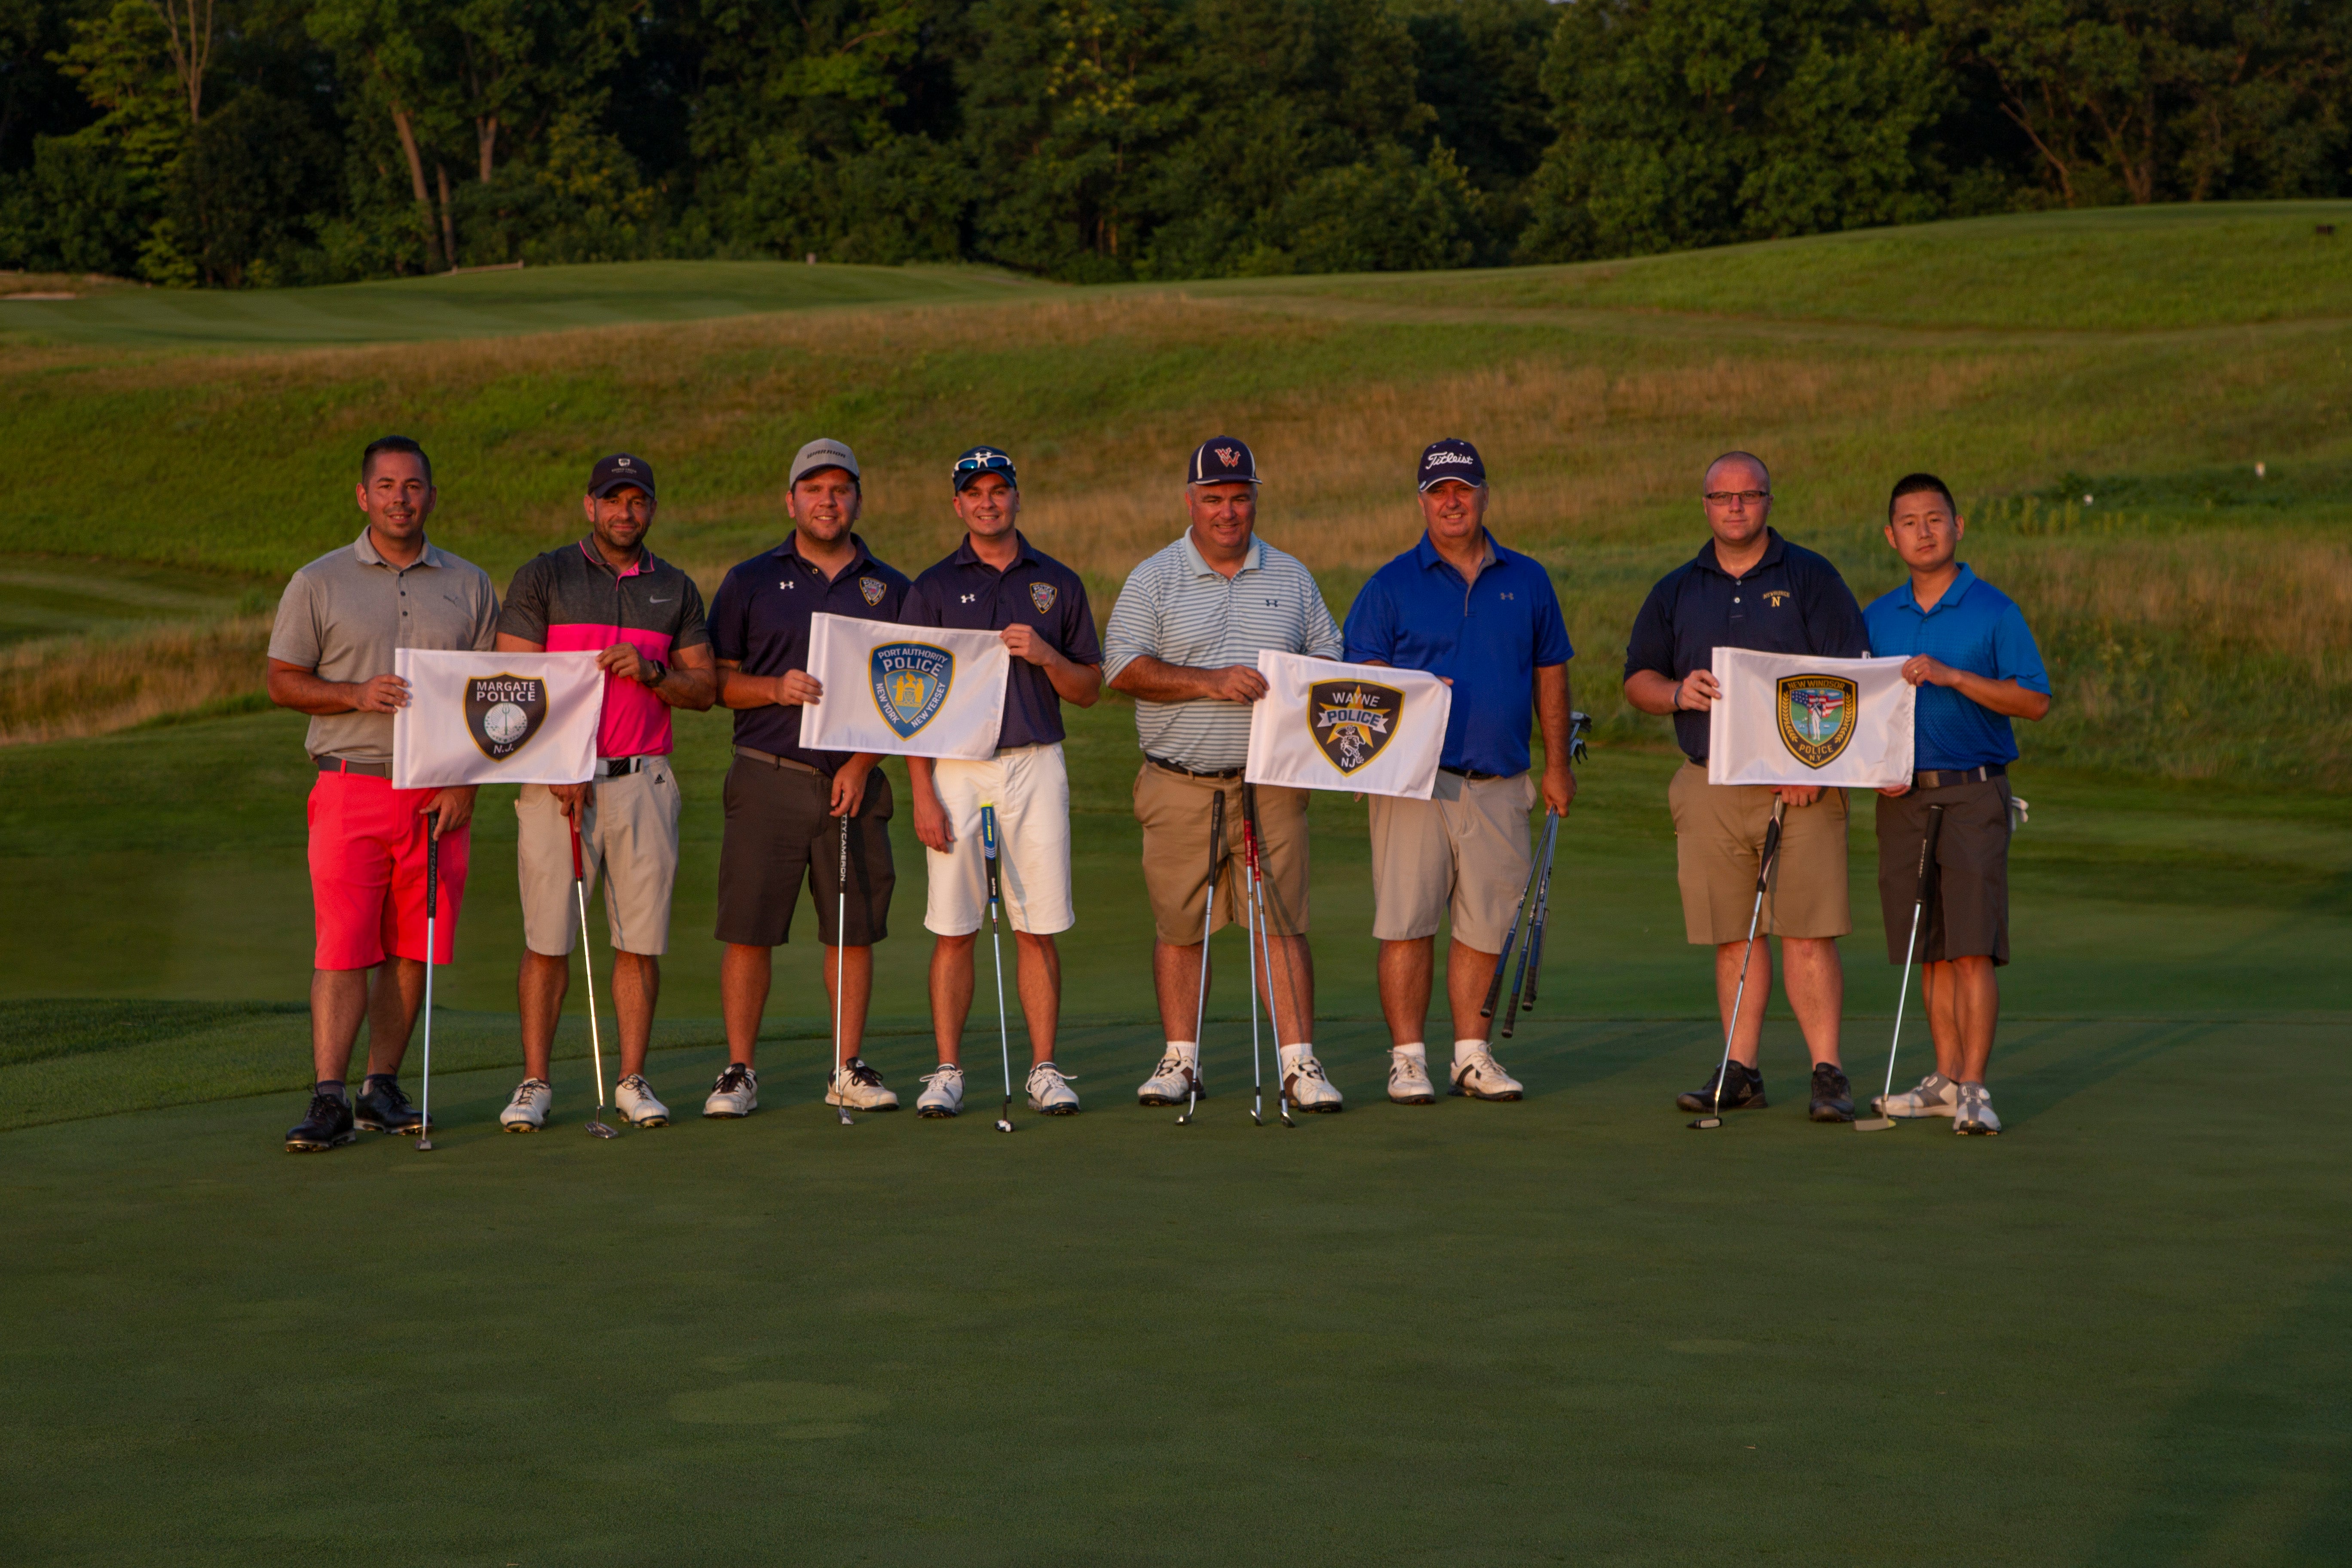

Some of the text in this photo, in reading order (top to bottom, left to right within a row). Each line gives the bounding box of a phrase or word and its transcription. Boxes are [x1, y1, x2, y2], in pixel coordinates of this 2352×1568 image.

[807, 450, 846, 459] WARRIOR
[1425, 451, 1473, 469] Titleist
[1771, 596, 1781, 607] N
[878, 648, 948, 664] PORT AUTHORITY
[882, 657, 943, 677] POLICE
[476, 681, 536, 692] MARGATE
[1787, 679, 1846, 690] NEW WINDSOR
[476, 691, 536, 702] POLICE
[1332, 692, 1381, 708] WAYNE
[876, 683, 900, 725] NEW YORK
[910, 710, 929, 728] NEW
[1326, 709, 1382, 727] POLICE
[493, 744, 514, 754] N.J.
[1799, 744, 1834, 755] POLICE
[1341, 757, 1356, 768] NJ
